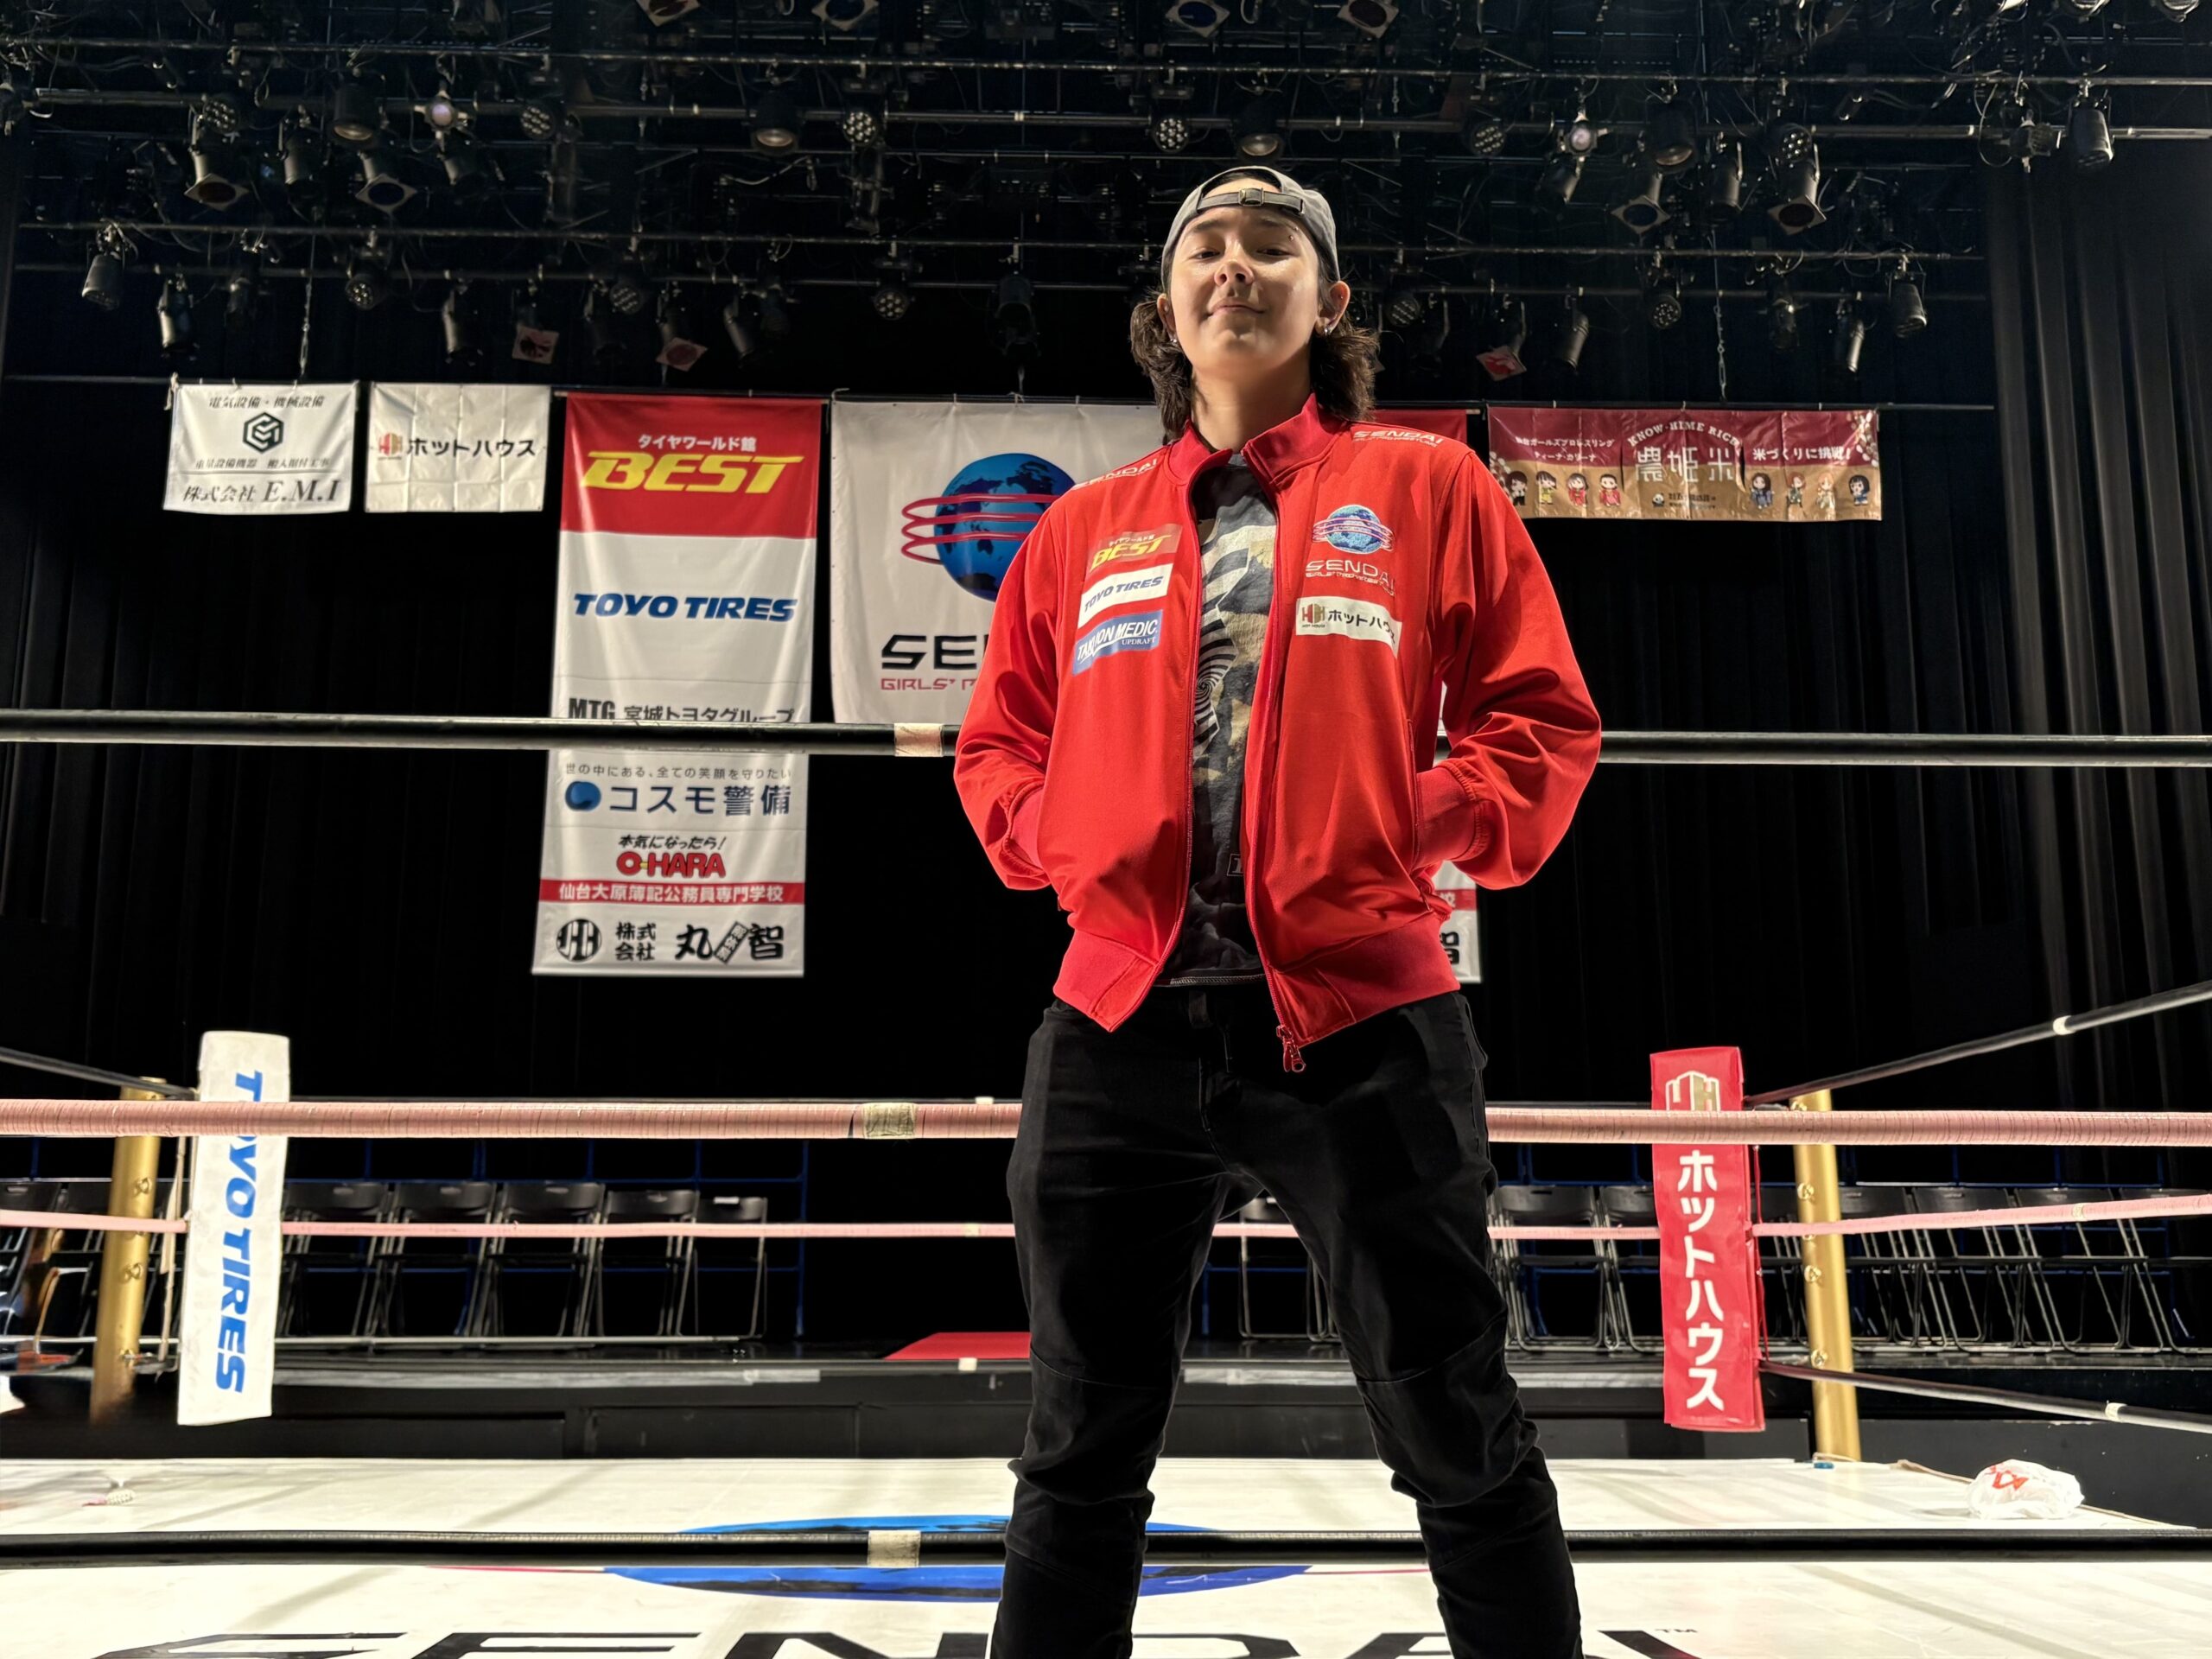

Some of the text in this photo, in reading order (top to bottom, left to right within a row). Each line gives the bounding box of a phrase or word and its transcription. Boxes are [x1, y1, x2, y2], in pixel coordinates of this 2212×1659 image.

[407, 438, 536, 457] ホットハウス
[638, 434, 757, 453] タイヤワールド館
[1354, 430, 1443, 444] SENDAI
[581, 451, 804, 493] BEST
[183, 486, 256, 502] 株式会社
[1090, 535, 1172, 572] BEST
[1306, 559, 1395, 591] SENDAI
[1084, 576, 1163, 613] TOYO TIRES
[574, 593, 798, 622] TOYO TIRES
[568, 698, 615, 720] MTG
[609, 785, 791, 817] コスモ警備
[559, 883, 784, 904] 仙台大原簿記公務員専門学校
[615, 922, 657, 940] 株式
[615, 942, 657, 961] 会社
[215, 1070, 263, 1393] TYO TIRES
[1677, 1149, 1724, 1412] ホットハウス
